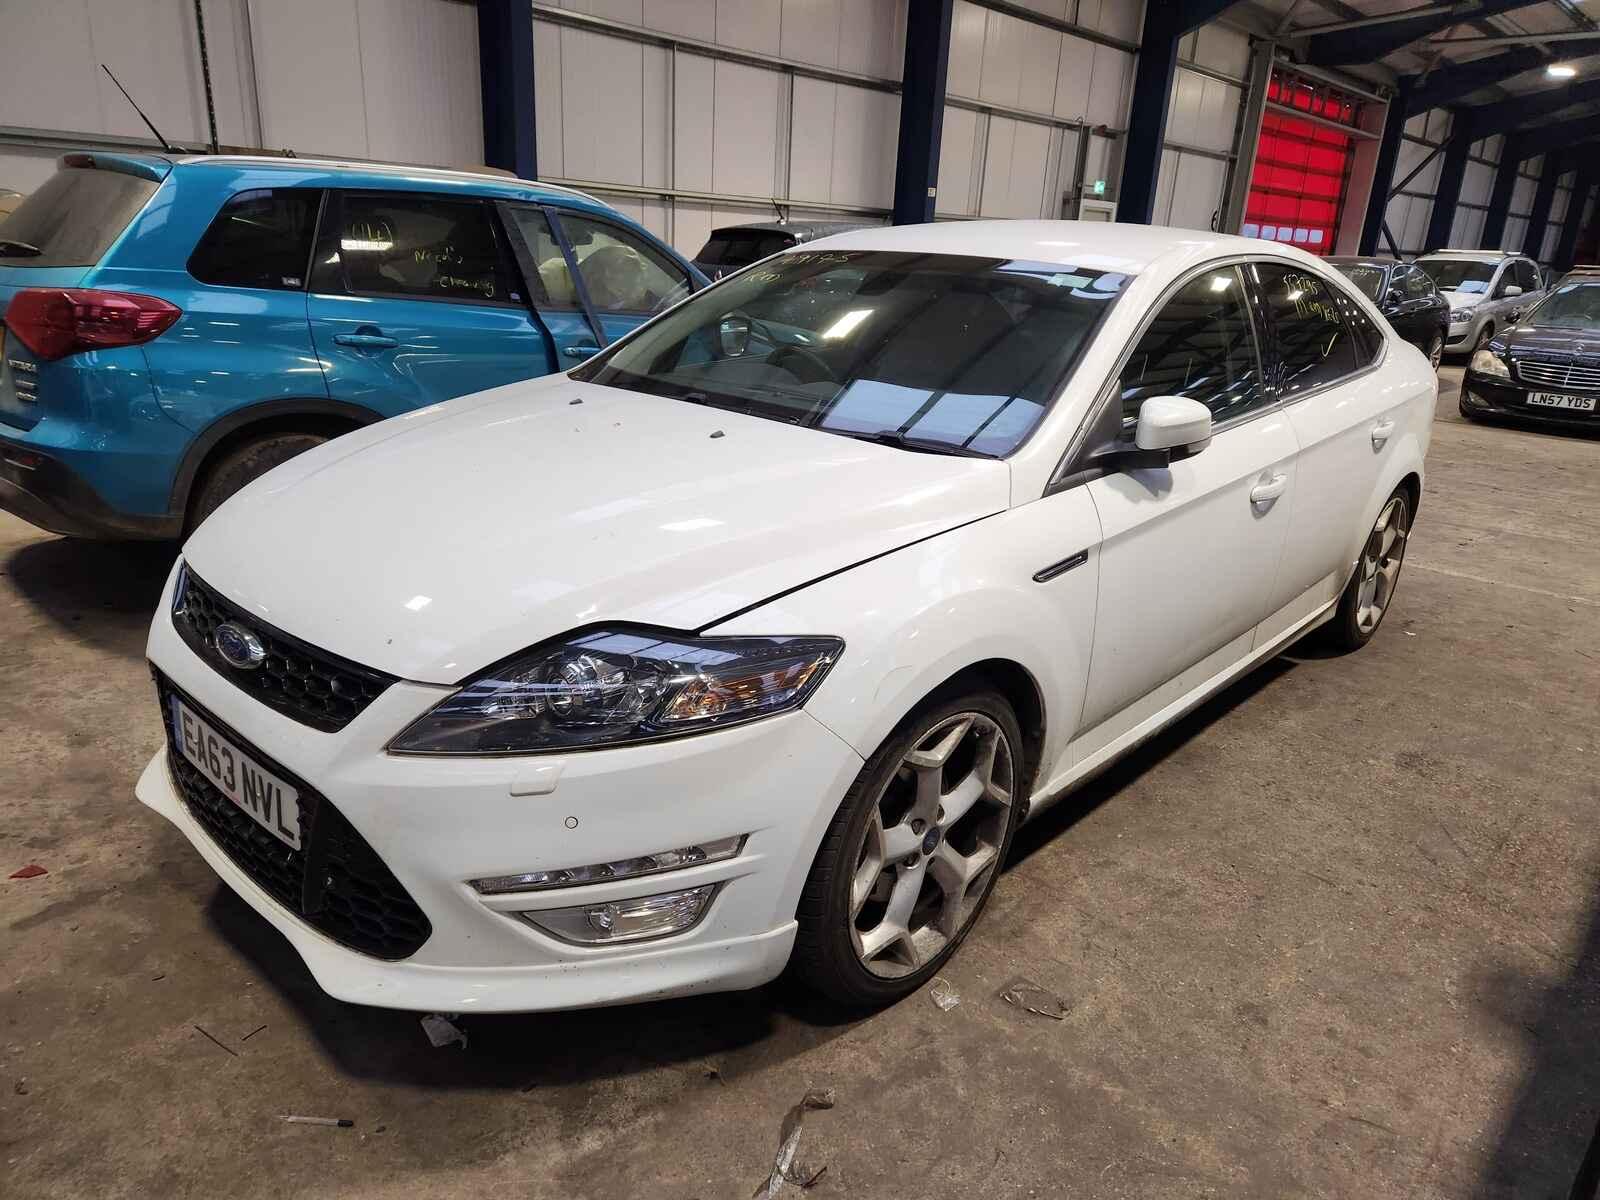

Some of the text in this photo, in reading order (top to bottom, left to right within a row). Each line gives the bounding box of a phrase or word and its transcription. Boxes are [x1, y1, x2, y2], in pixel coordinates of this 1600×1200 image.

[1531, 393, 1591, 409] LN57 YDS
[182, 710, 295, 841] EA63 NVL
